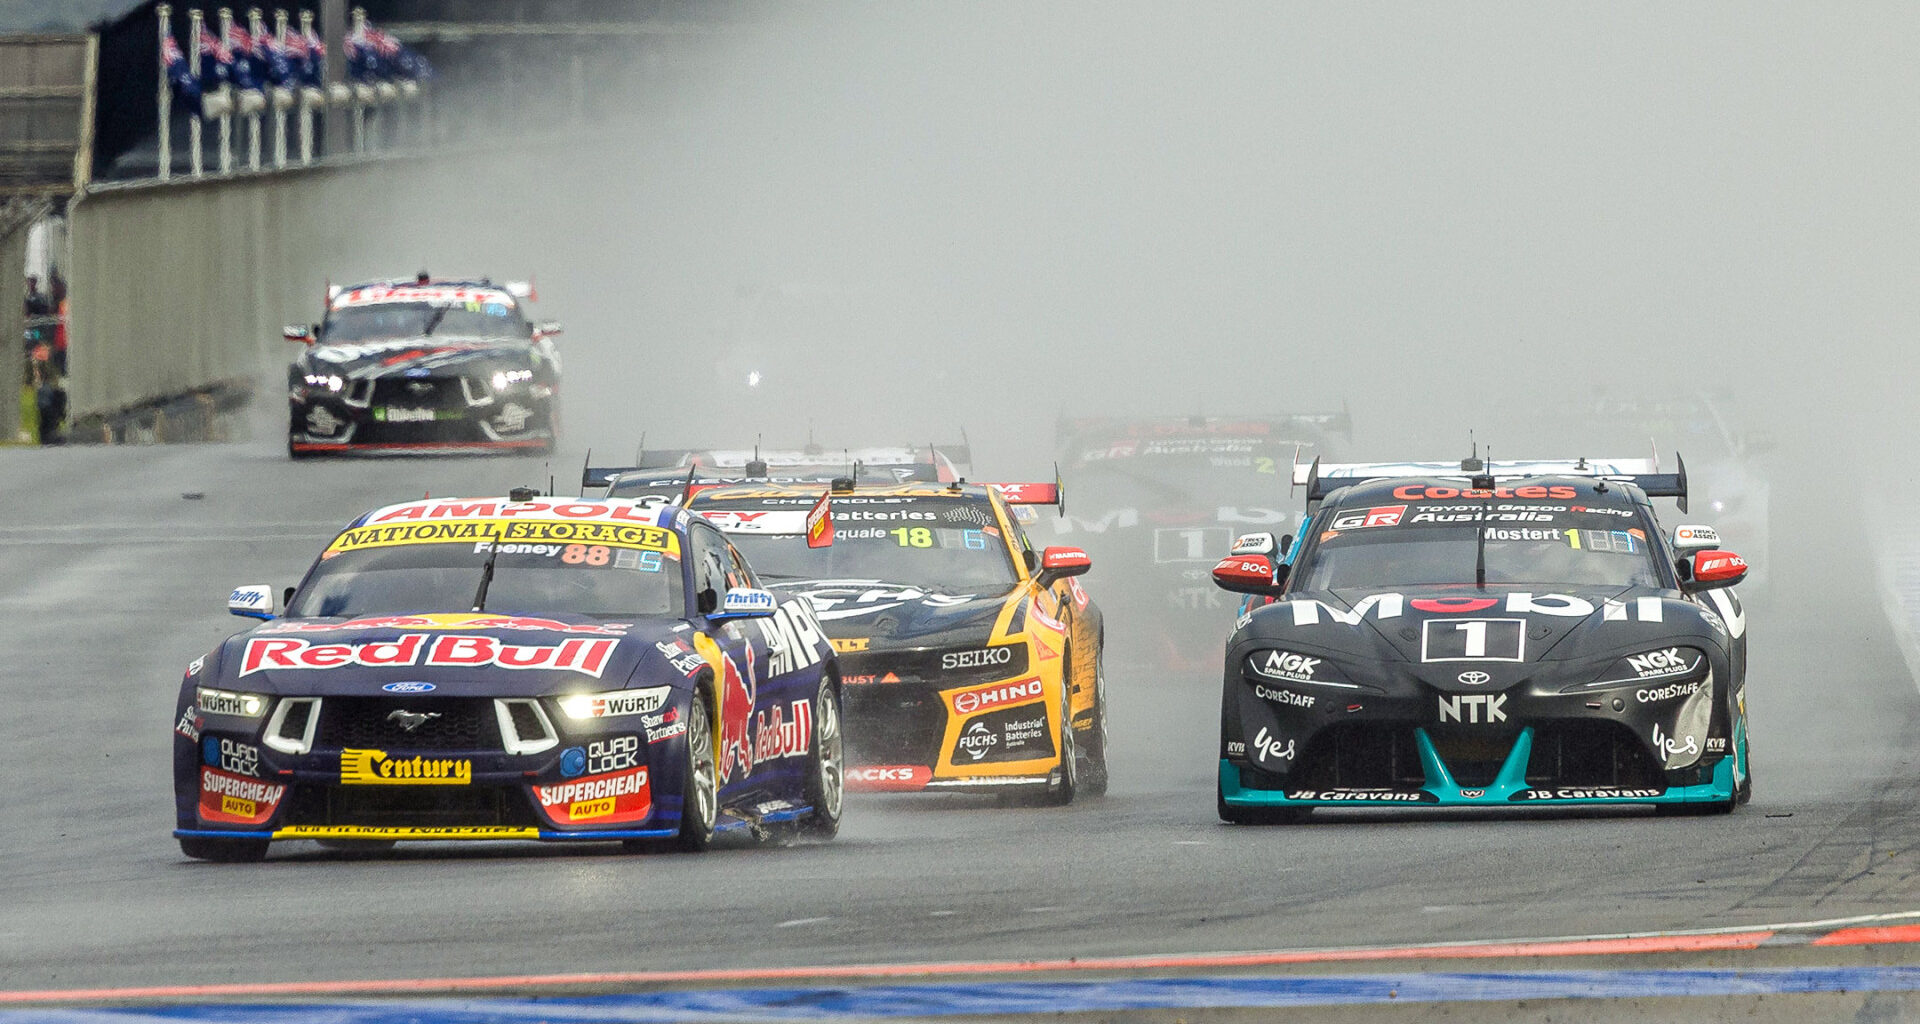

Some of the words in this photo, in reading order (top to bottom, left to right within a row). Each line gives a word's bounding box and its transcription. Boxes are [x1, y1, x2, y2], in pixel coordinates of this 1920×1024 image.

[1254, 457, 1275, 474] 2
[649, 477, 836, 487] CHEVROLE
[1393, 485, 1577, 500] Coates
[376, 502, 651, 523] AMPOL
[830, 510, 937, 521] atteries
[1333, 511, 1401, 528] GR
[1410, 512, 1554, 523] Australia
[1570, 506, 1633, 517] Racing
[339, 524, 498, 547] NATIONAL
[509, 522, 667, 548] STORAGE
[891, 527, 932, 547] 18
[1477, 527, 1560, 540] Mostert
[1564, 529, 1581, 550] 1
[473, 542, 563, 556] Feeney
[562, 544, 611, 566] 88
[1241, 562, 1269, 574] BOC
[229, 590, 264, 605] Thrifty
[725, 592, 773, 607] Thrifty
[1291, 592, 1663, 626] Mobil
[1455, 621, 1487, 657] 1
[242, 635, 428, 677] Red
[427, 635, 619, 678] Bull
[942, 648, 1011, 669] SEIKO
[1265, 650, 1321, 675] NGK
[1626, 647, 1686, 672] NGK
[1264, 668, 1286, 676] SPARK
[1286, 671, 1311, 680] PLUGS
[1638, 669, 1663, 677] SPARK
[1665, 664, 1688, 675] PLUGS
[980, 680, 1043, 705] HINO
[1438, 693, 1508, 723] NTK
[641, 714, 666, 729] Shaw
[1005, 717, 1044, 731] Industrial
[646, 722, 686, 743] Partners
[959, 733, 998, 749] FUCHS
[1005, 729, 1042, 741] Batteries
[221, 738, 258, 762] QUAD
[588, 737, 638, 757] QUAD
[1707, 738, 1726, 749] KYB
[222, 756, 260, 778] LOCK
[588, 750, 637, 774] LOCK
[203, 771, 285, 805] SUPERCHEAP
[540, 771, 648, 807] SUPERCHEAP
[1289, 790, 1315, 800] JB
[1319, 789, 1420, 800] Caravans
[1527, 789, 1552, 799] JB
[1556, 786, 1661, 799] Caravans
[225, 798, 253, 814] AUTO
[573, 801, 611, 817] AUTO
